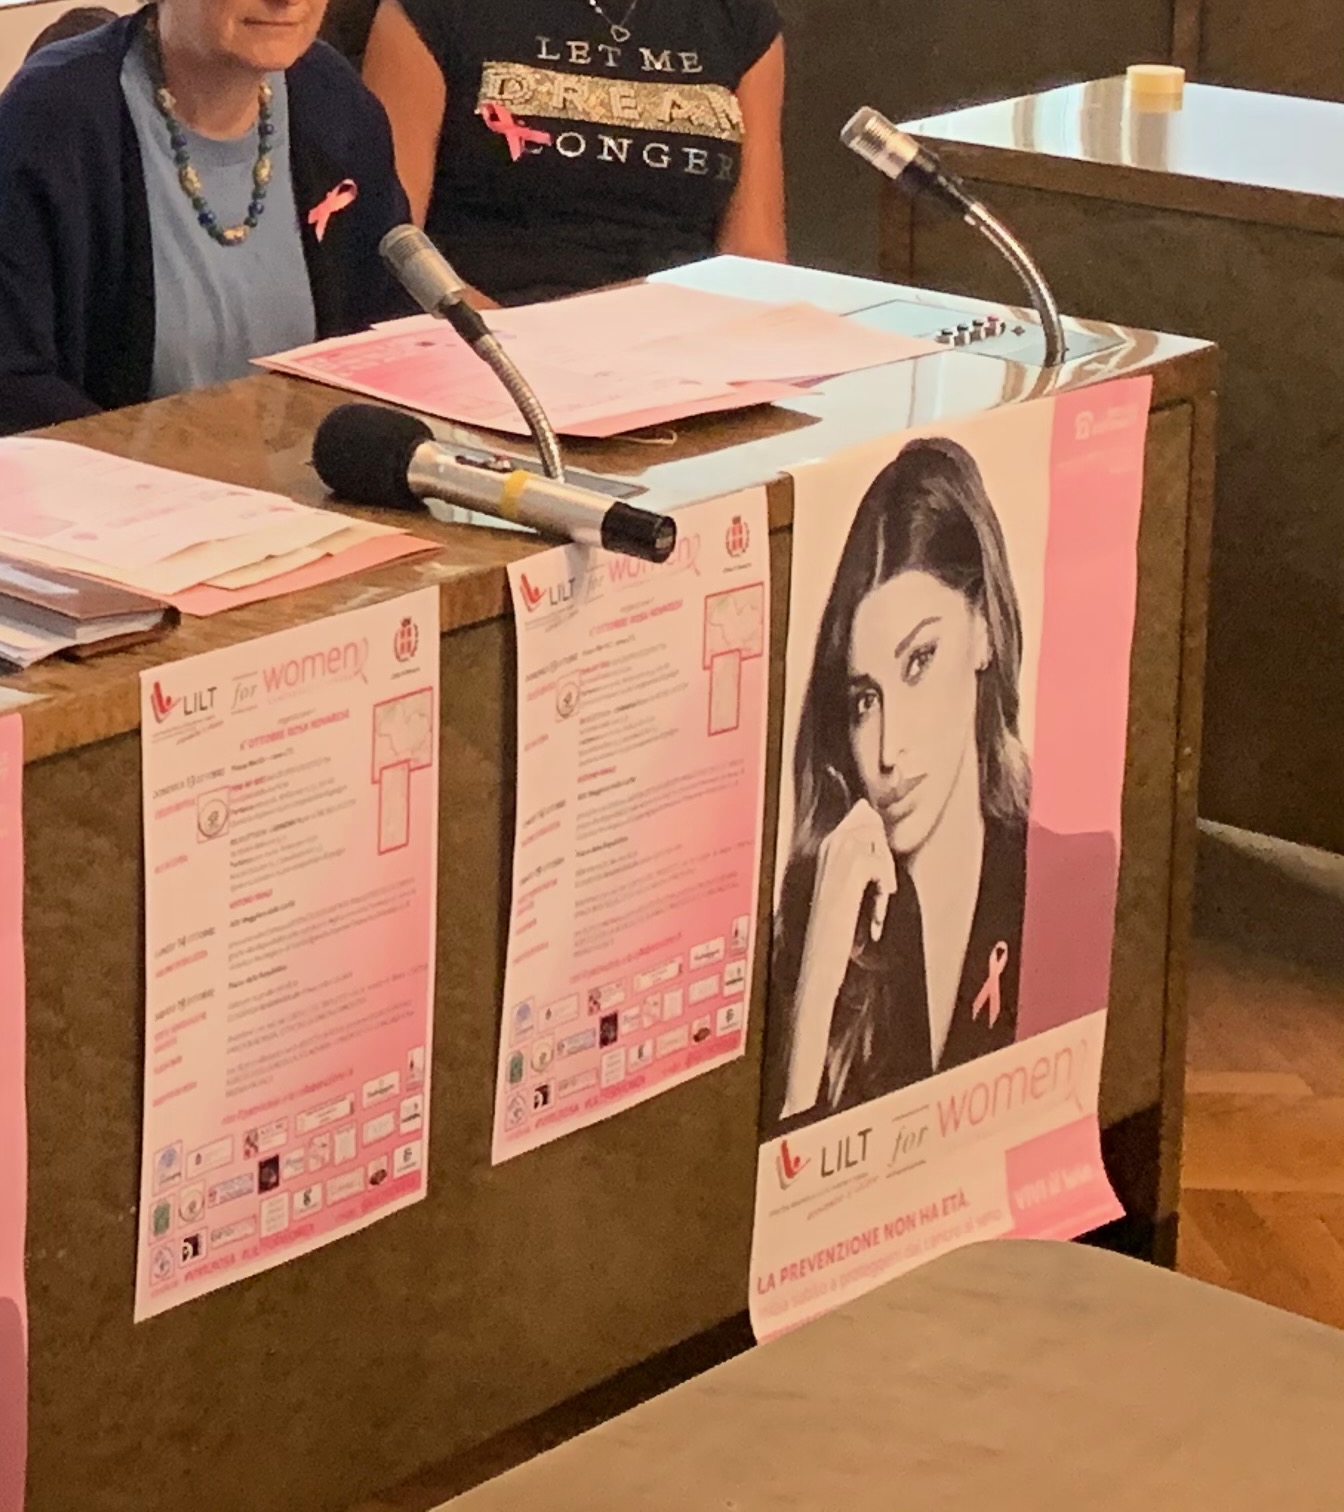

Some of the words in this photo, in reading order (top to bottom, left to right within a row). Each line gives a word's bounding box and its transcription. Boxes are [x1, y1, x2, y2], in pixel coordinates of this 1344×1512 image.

[535, 36, 622, 68] LET
[639, 47, 704, 74] ME
[524, 132, 736, 182] ONGER
[183, 686, 217, 716] LILT
[231, 682, 258, 711] for
[263, 641, 358, 693] women
[820, 1129, 872, 1178] LILT
[886, 1124, 930, 1169] for
[937, 1047, 1074, 1138] women
[757, 1272, 777, 1295] LA
[780, 1227, 880, 1285] PREVENZIONE
[883, 1211, 917, 1240] NON
[919, 1201, 939, 1226] HA
